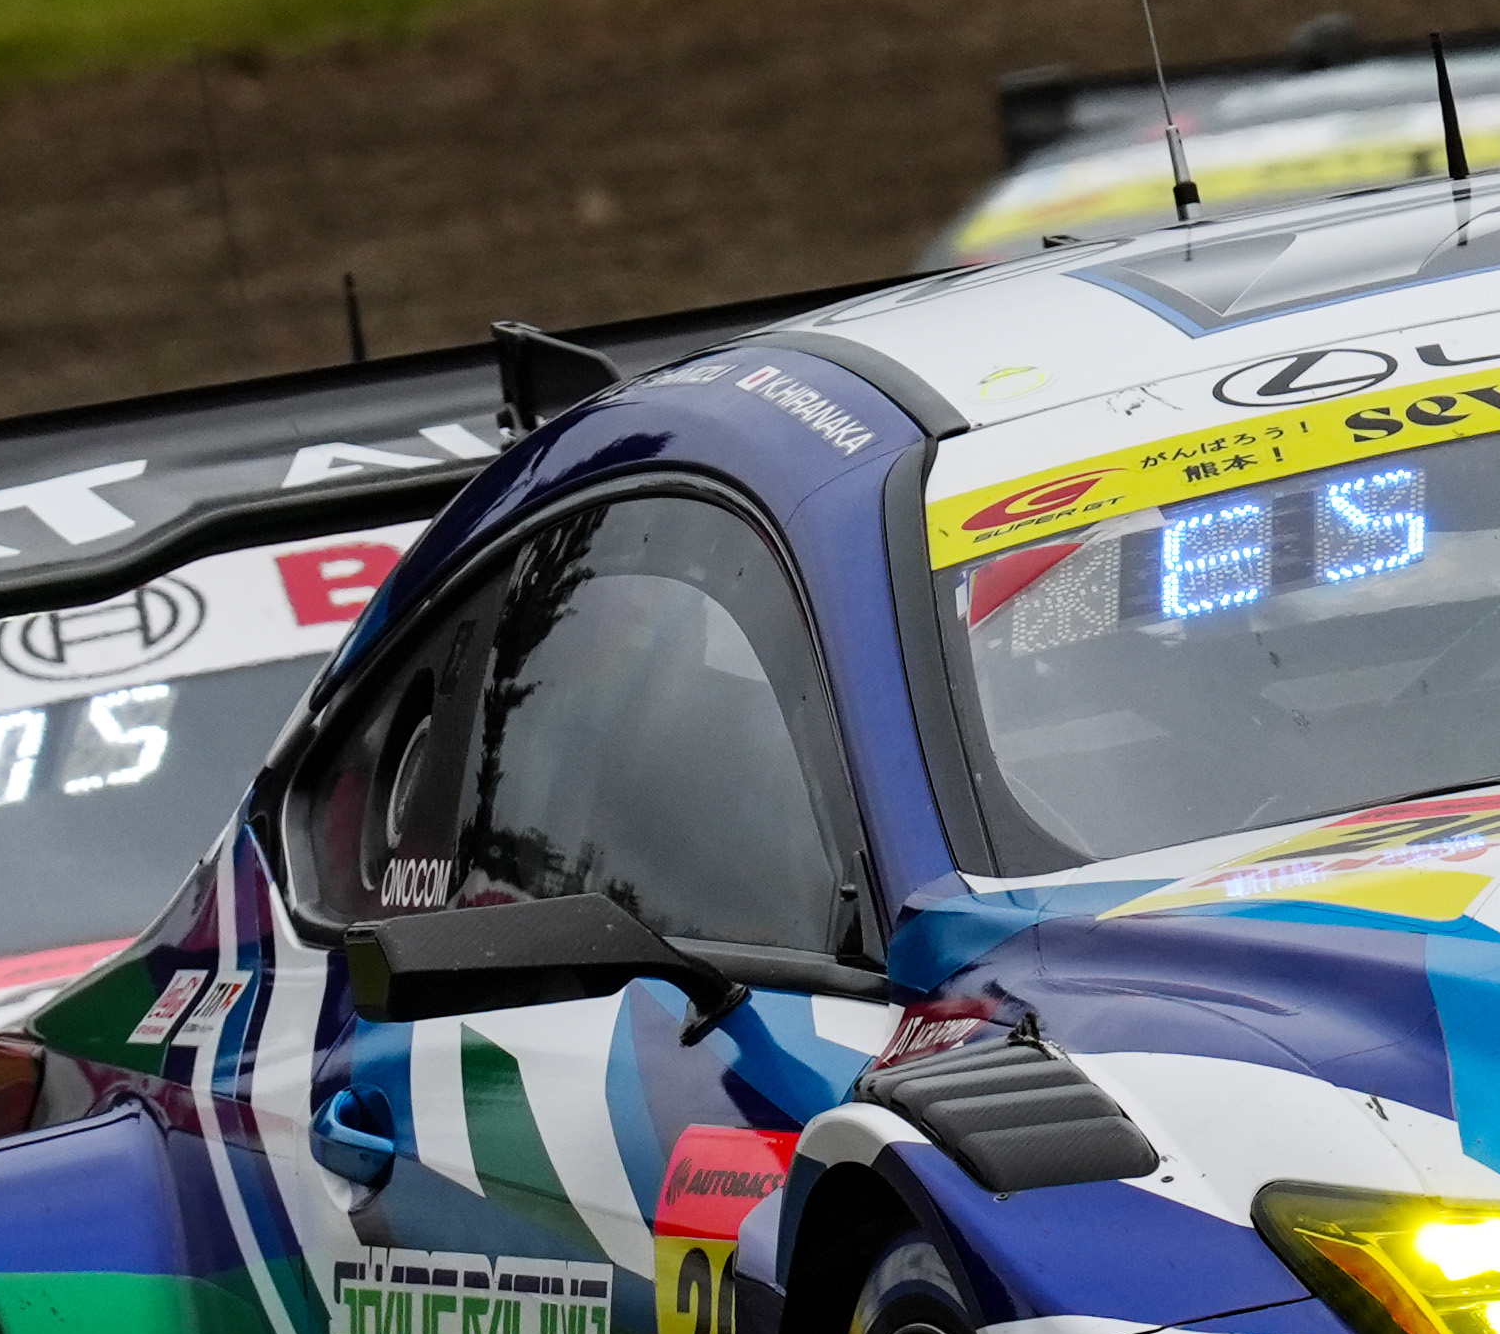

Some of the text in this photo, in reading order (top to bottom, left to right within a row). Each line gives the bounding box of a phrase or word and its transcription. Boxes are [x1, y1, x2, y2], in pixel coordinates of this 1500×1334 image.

[757, 373, 875, 457] K.HIRANAKA
[972, 495, 1128, 544] SUPER GT
[381, 857, 452, 908] ONOCOM
